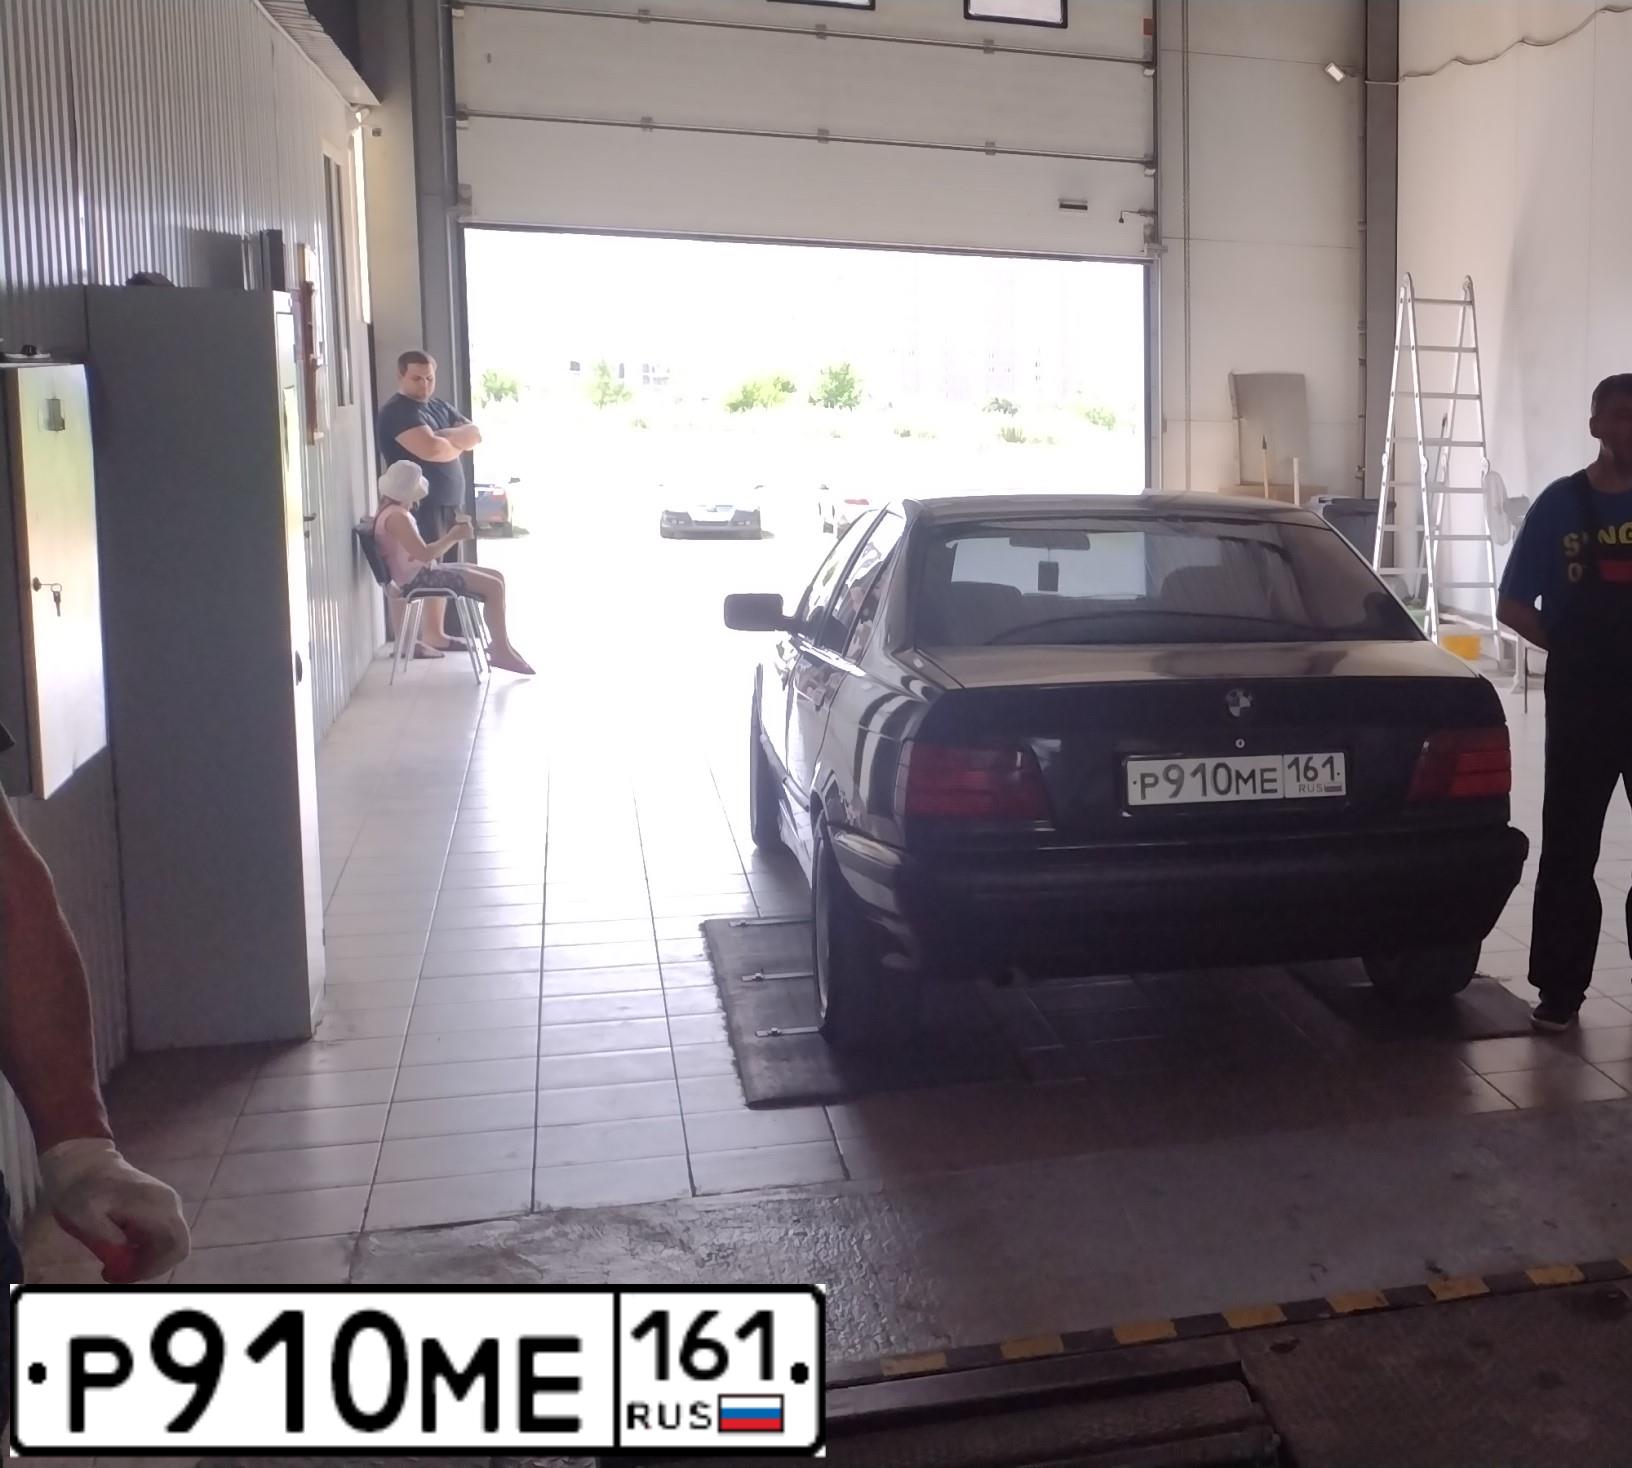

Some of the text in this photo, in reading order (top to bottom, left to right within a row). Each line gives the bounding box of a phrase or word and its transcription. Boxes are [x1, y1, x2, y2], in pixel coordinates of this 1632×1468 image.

[1139, 755, 1336, 801] Р910МЕ 161
[1299, 783, 1323, 793] RUS
